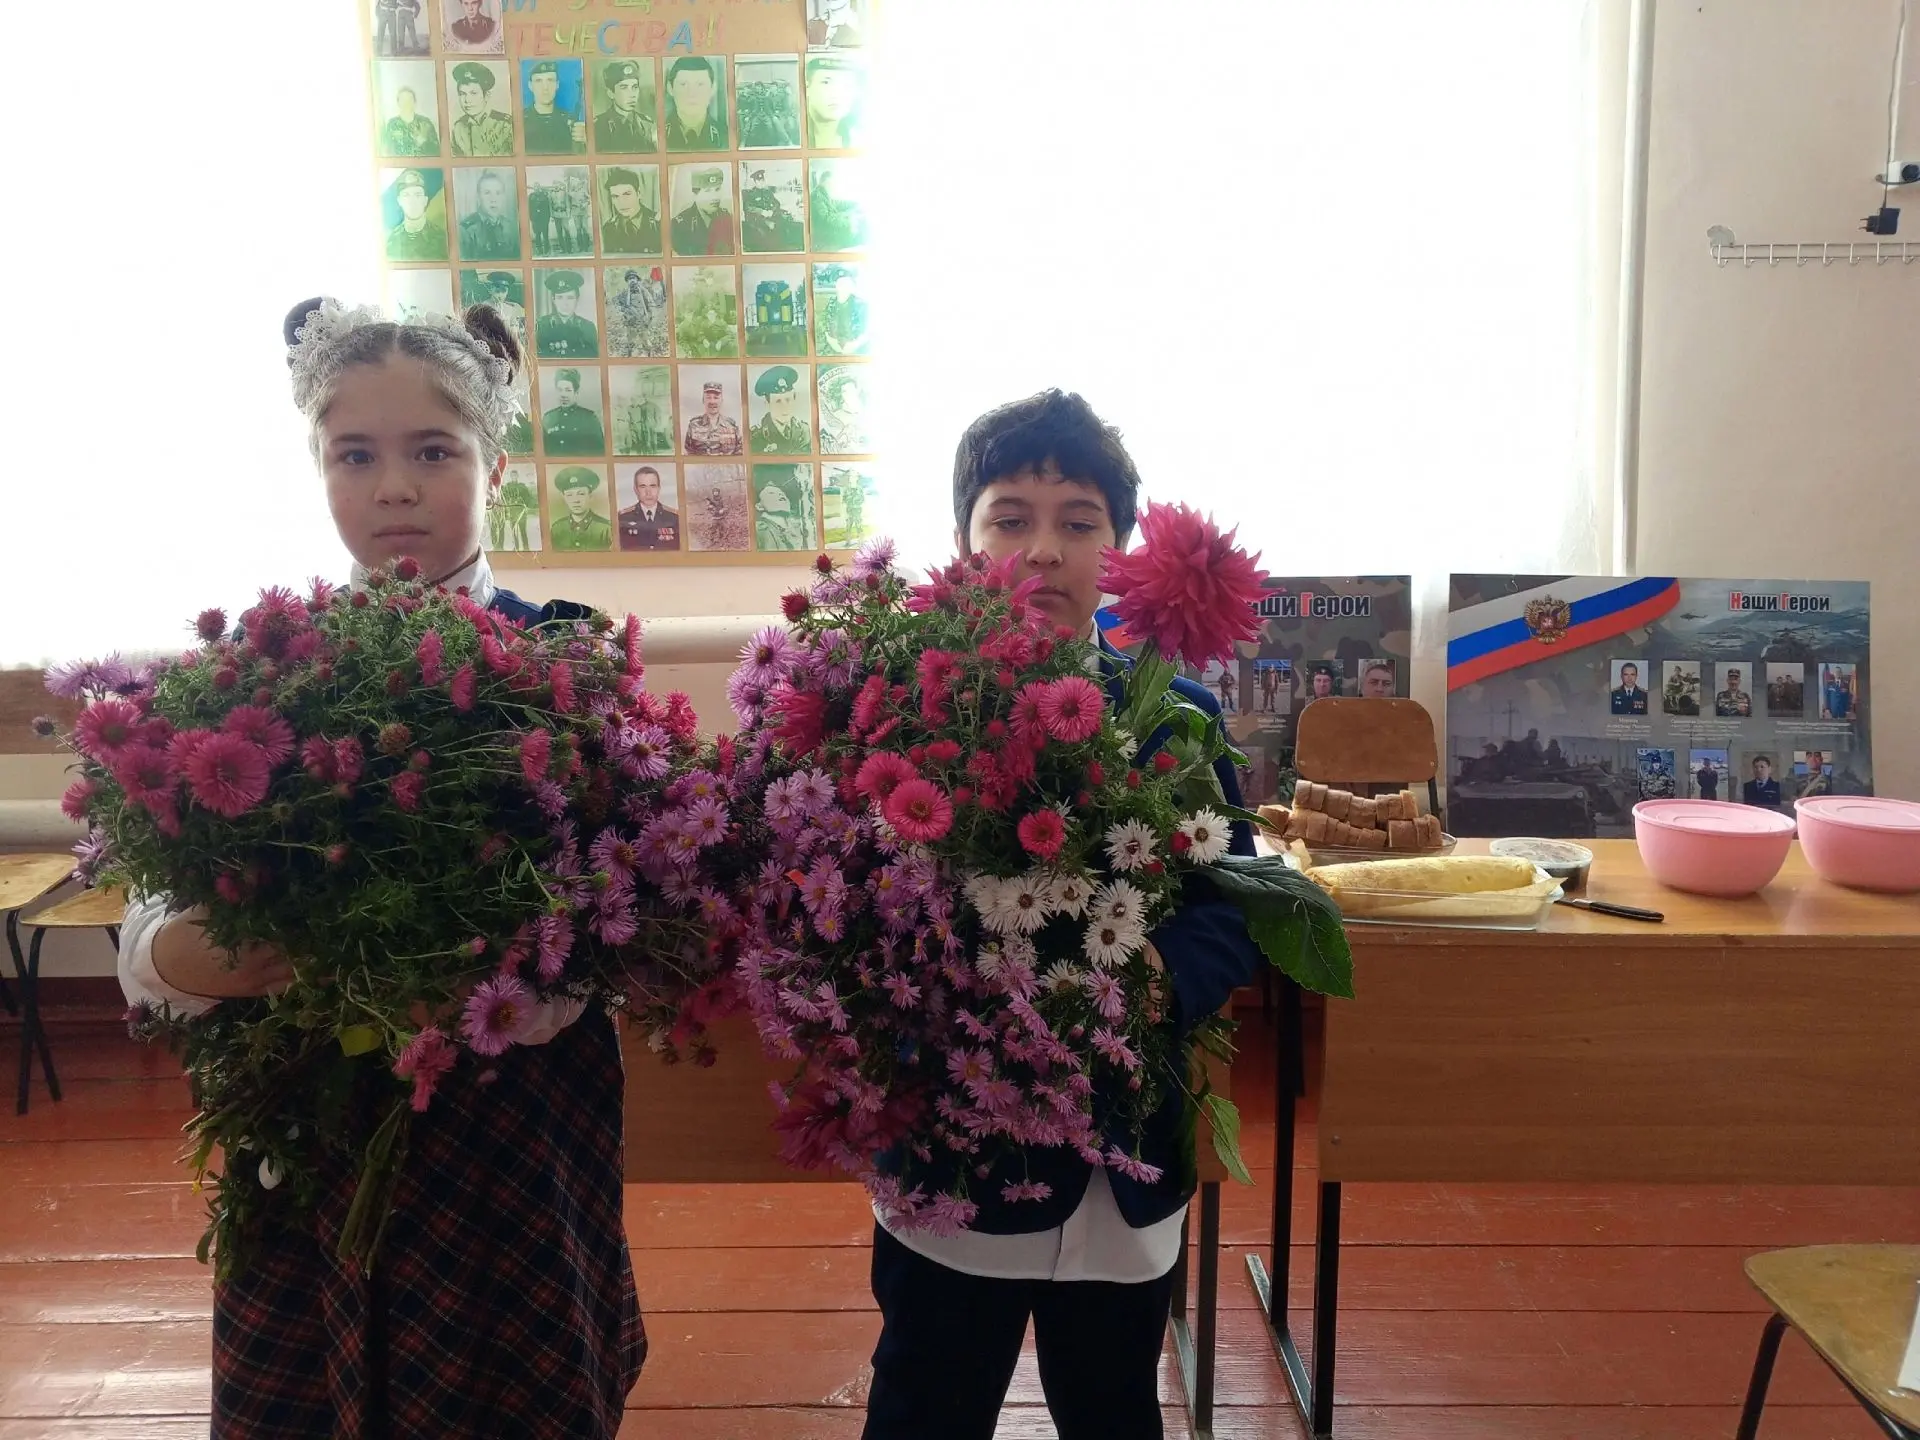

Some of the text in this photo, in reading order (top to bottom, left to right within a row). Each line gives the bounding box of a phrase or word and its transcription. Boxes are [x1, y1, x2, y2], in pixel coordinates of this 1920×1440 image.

[1250, 592, 1371, 619] ши Герои
[1729, 591, 1831, 613] Наши Герои
